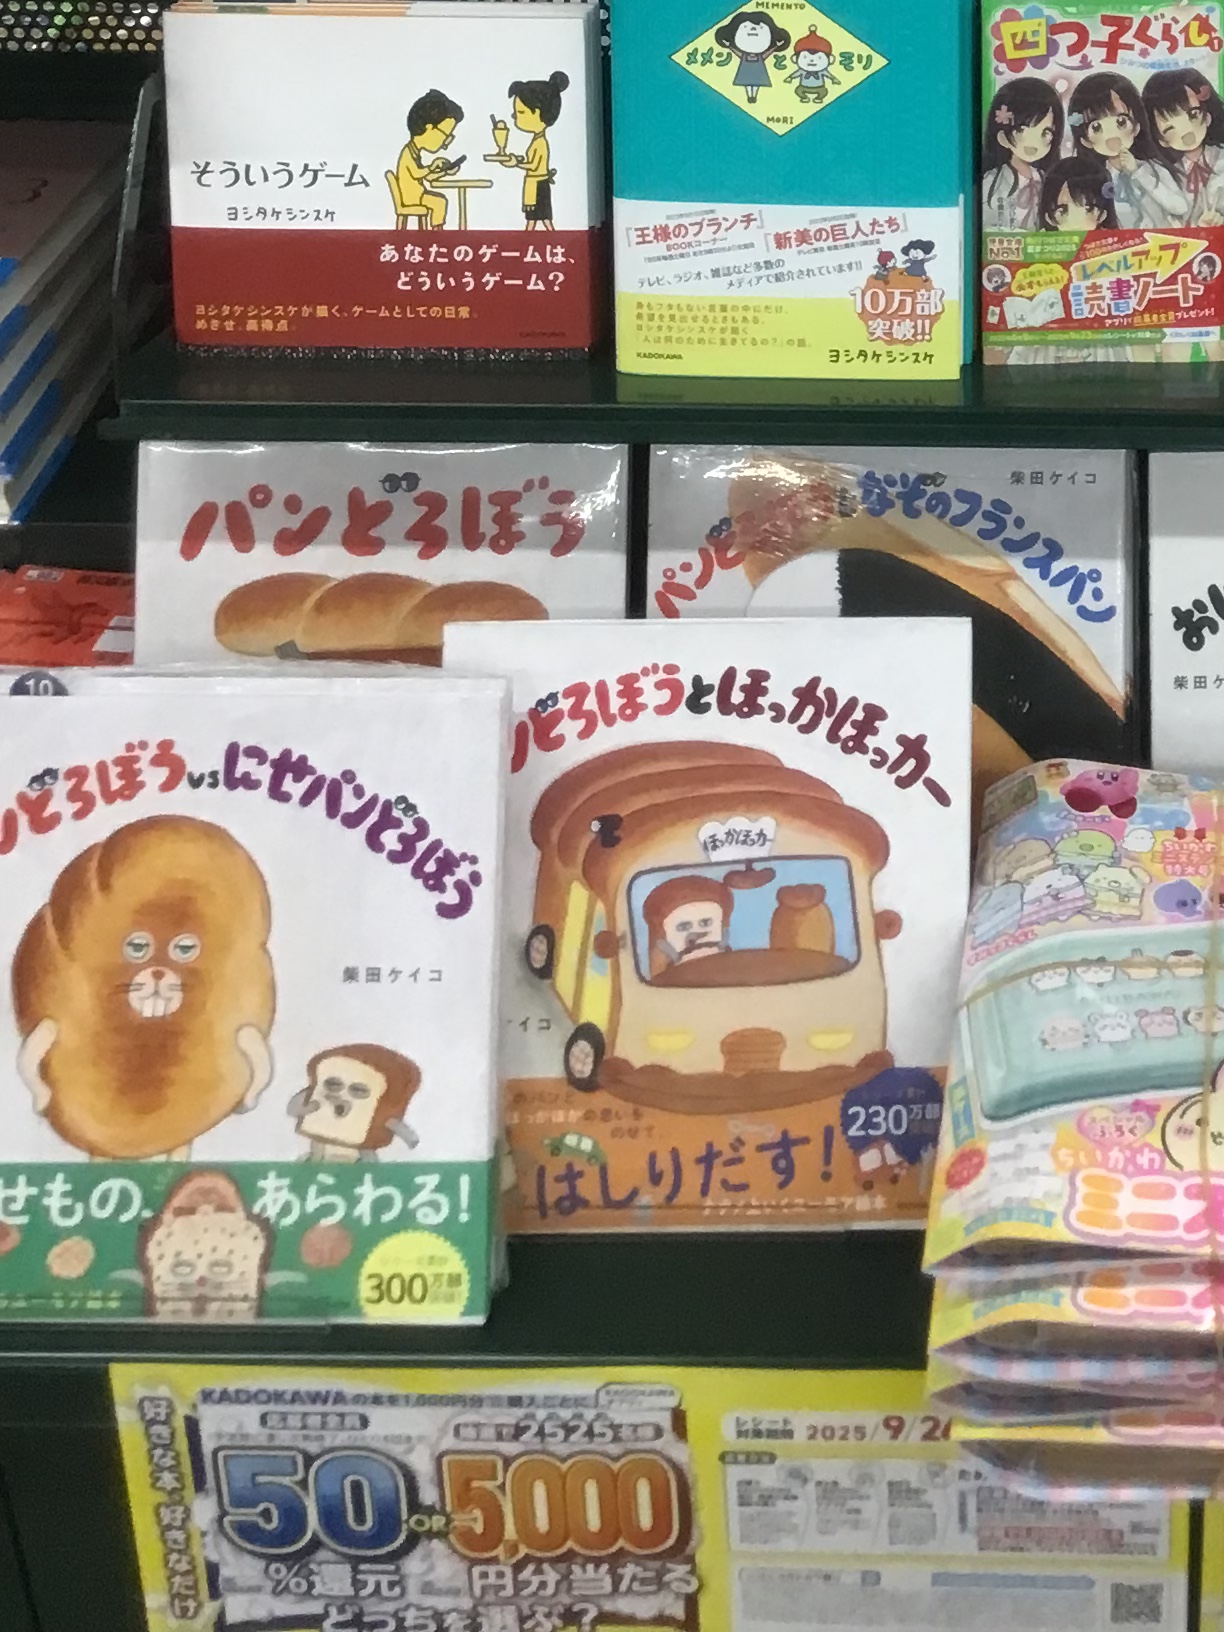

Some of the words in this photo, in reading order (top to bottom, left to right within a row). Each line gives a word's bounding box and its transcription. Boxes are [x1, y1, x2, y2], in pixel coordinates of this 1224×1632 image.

[755, 0, 806, 11] MEMENTO
[685, 47, 733, 68] メメン
[773, 53, 788, 70] と
[838, 50, 873, 71] モリ
[766, 115, 794, 126] MORI
[189, 159, 371, 191] そういうゲーム
[227, 206, 337, 224] ヨシタケシンスケ
[379, 242, 577, 266] あなたのゲームは、
[1081, 241, 1188, 281] レベルアップ
[395, 269, 566, 294] どういうゲーム?
[850, 286, 945, 316] 10万部
[1071, 273, 1204, 319] 読書ノート
[867, 318, 931, 343] 突破!!
[828, 347, 936, 366] ヨシタケシンスケ
[1010, 470, 1097, 486] 柴田ケイコ
[178, 473, 588, 561] パンどろぼう
[25, 678, 54, 696] 10
[341, 966, 444, 985] 柴田ケイコ
[1054, 1143, 1164, 1172] ちいかわ
[536, 1125, 833, 1219] はしりだす!
[252, 1171, 471, 1228] あらわる!
[215, 1446, 409, 1556] 50
[443, 1452, 680, 1562] 5,000
[409, 1513, 449, 1532] OR
[268, 1564, 399, 1596] %還元
[469, 1564, 697, 1596] 円分当たる
